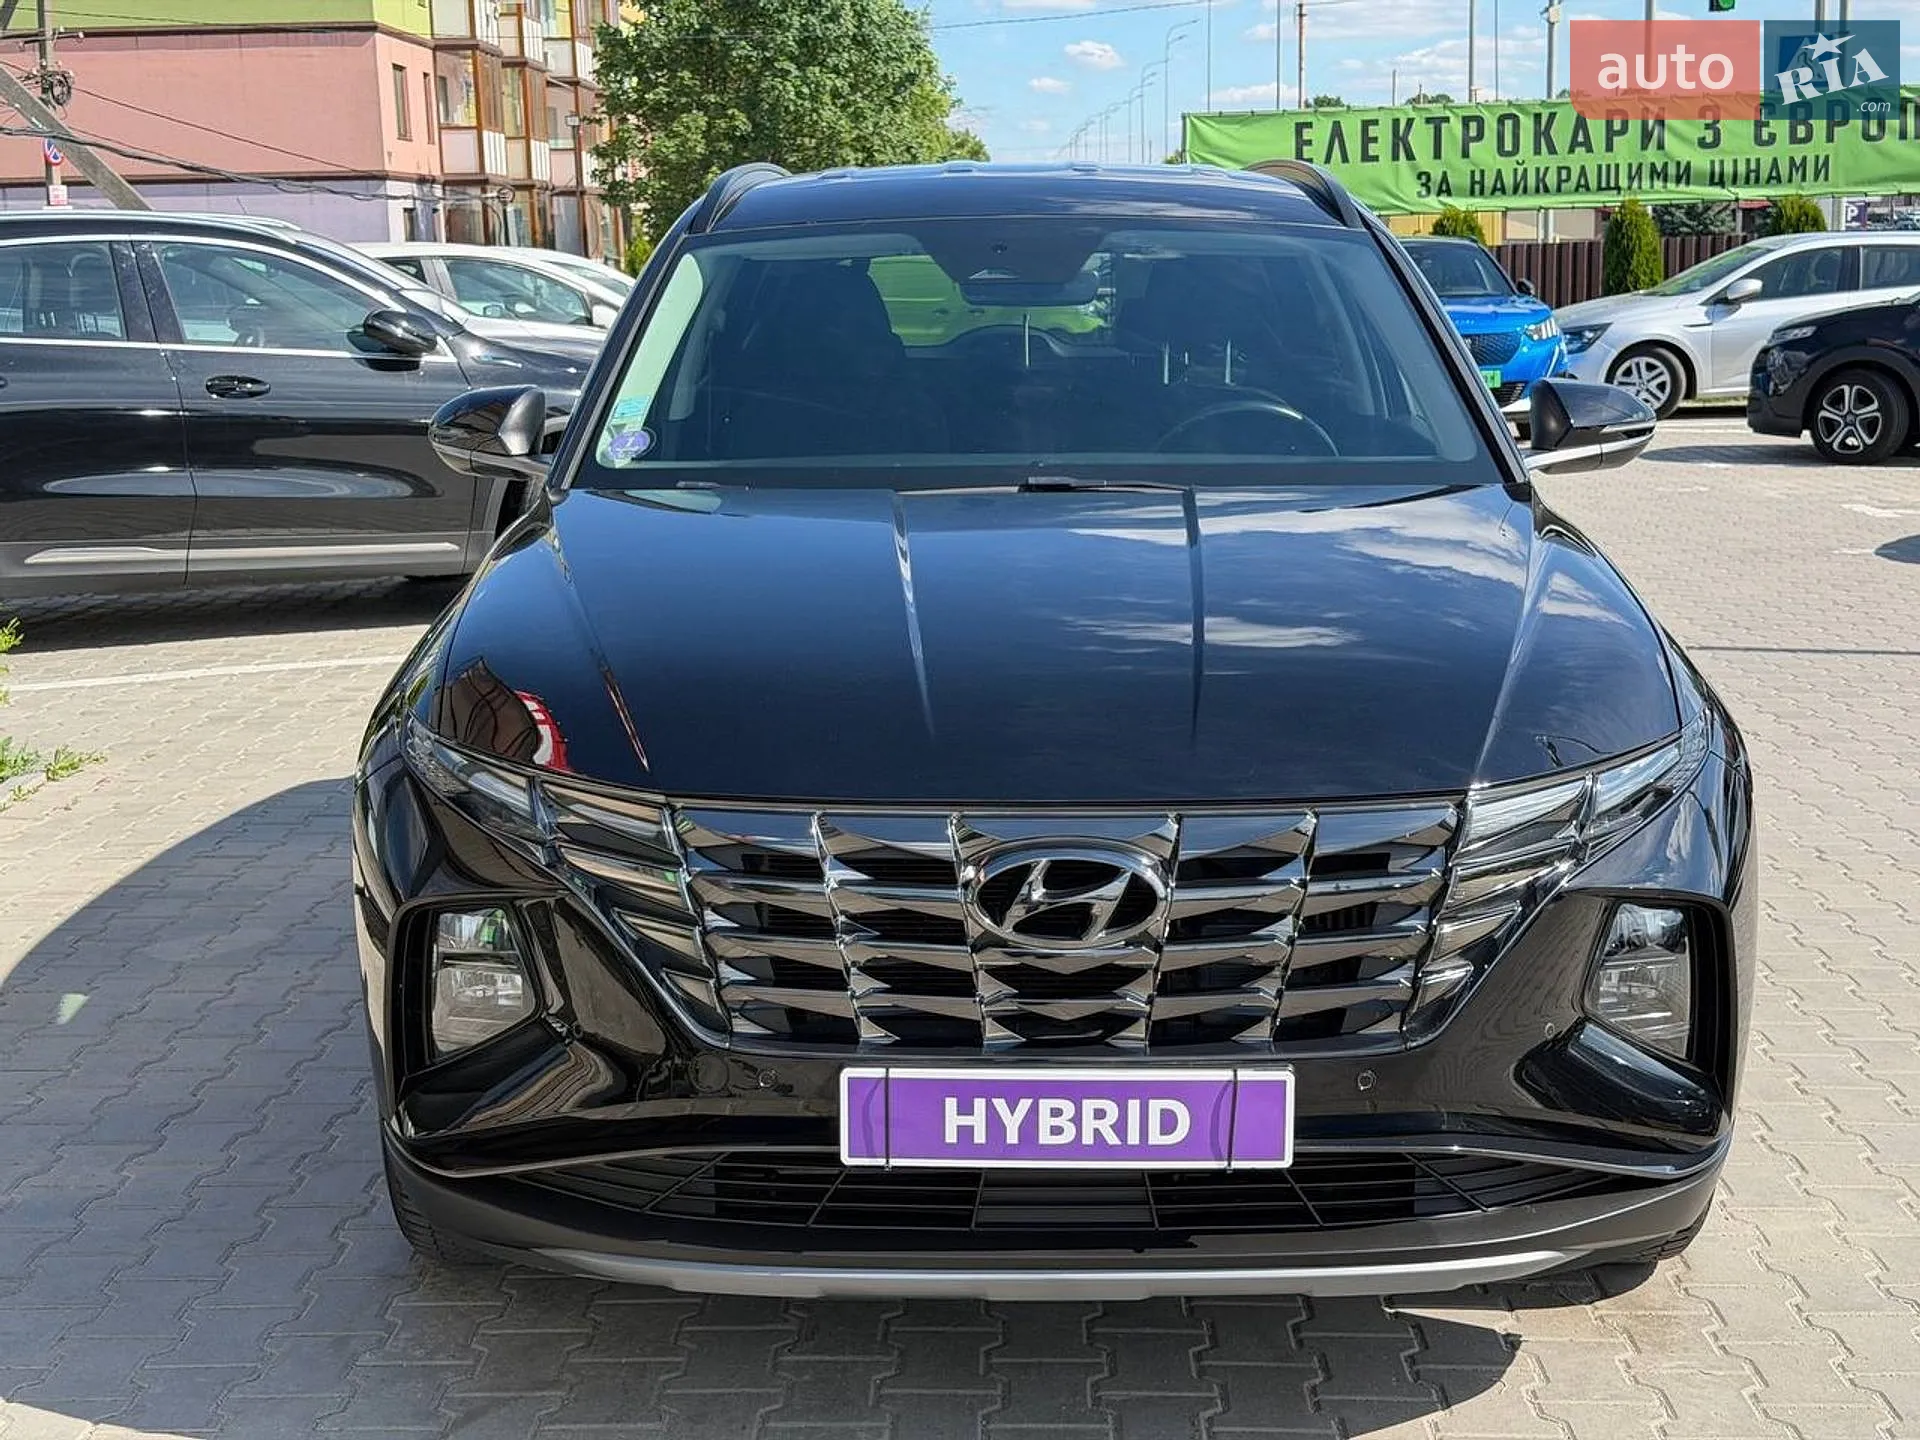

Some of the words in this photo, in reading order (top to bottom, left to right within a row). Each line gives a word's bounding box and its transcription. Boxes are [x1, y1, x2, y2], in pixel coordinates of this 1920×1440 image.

[1295, 106, 1666, 164] ЕЛЕКТРОКАРИ
[1697, 105, 1722, 150] З
[1416, 170, 1453, 198] ЗА
[1469, 160, 1692, 197] НАЙКРАЩИМИ
[1708, 154, 1830, 190] ЦІНАМИ
[943, 1097, 1191, 1147] HYBRID
